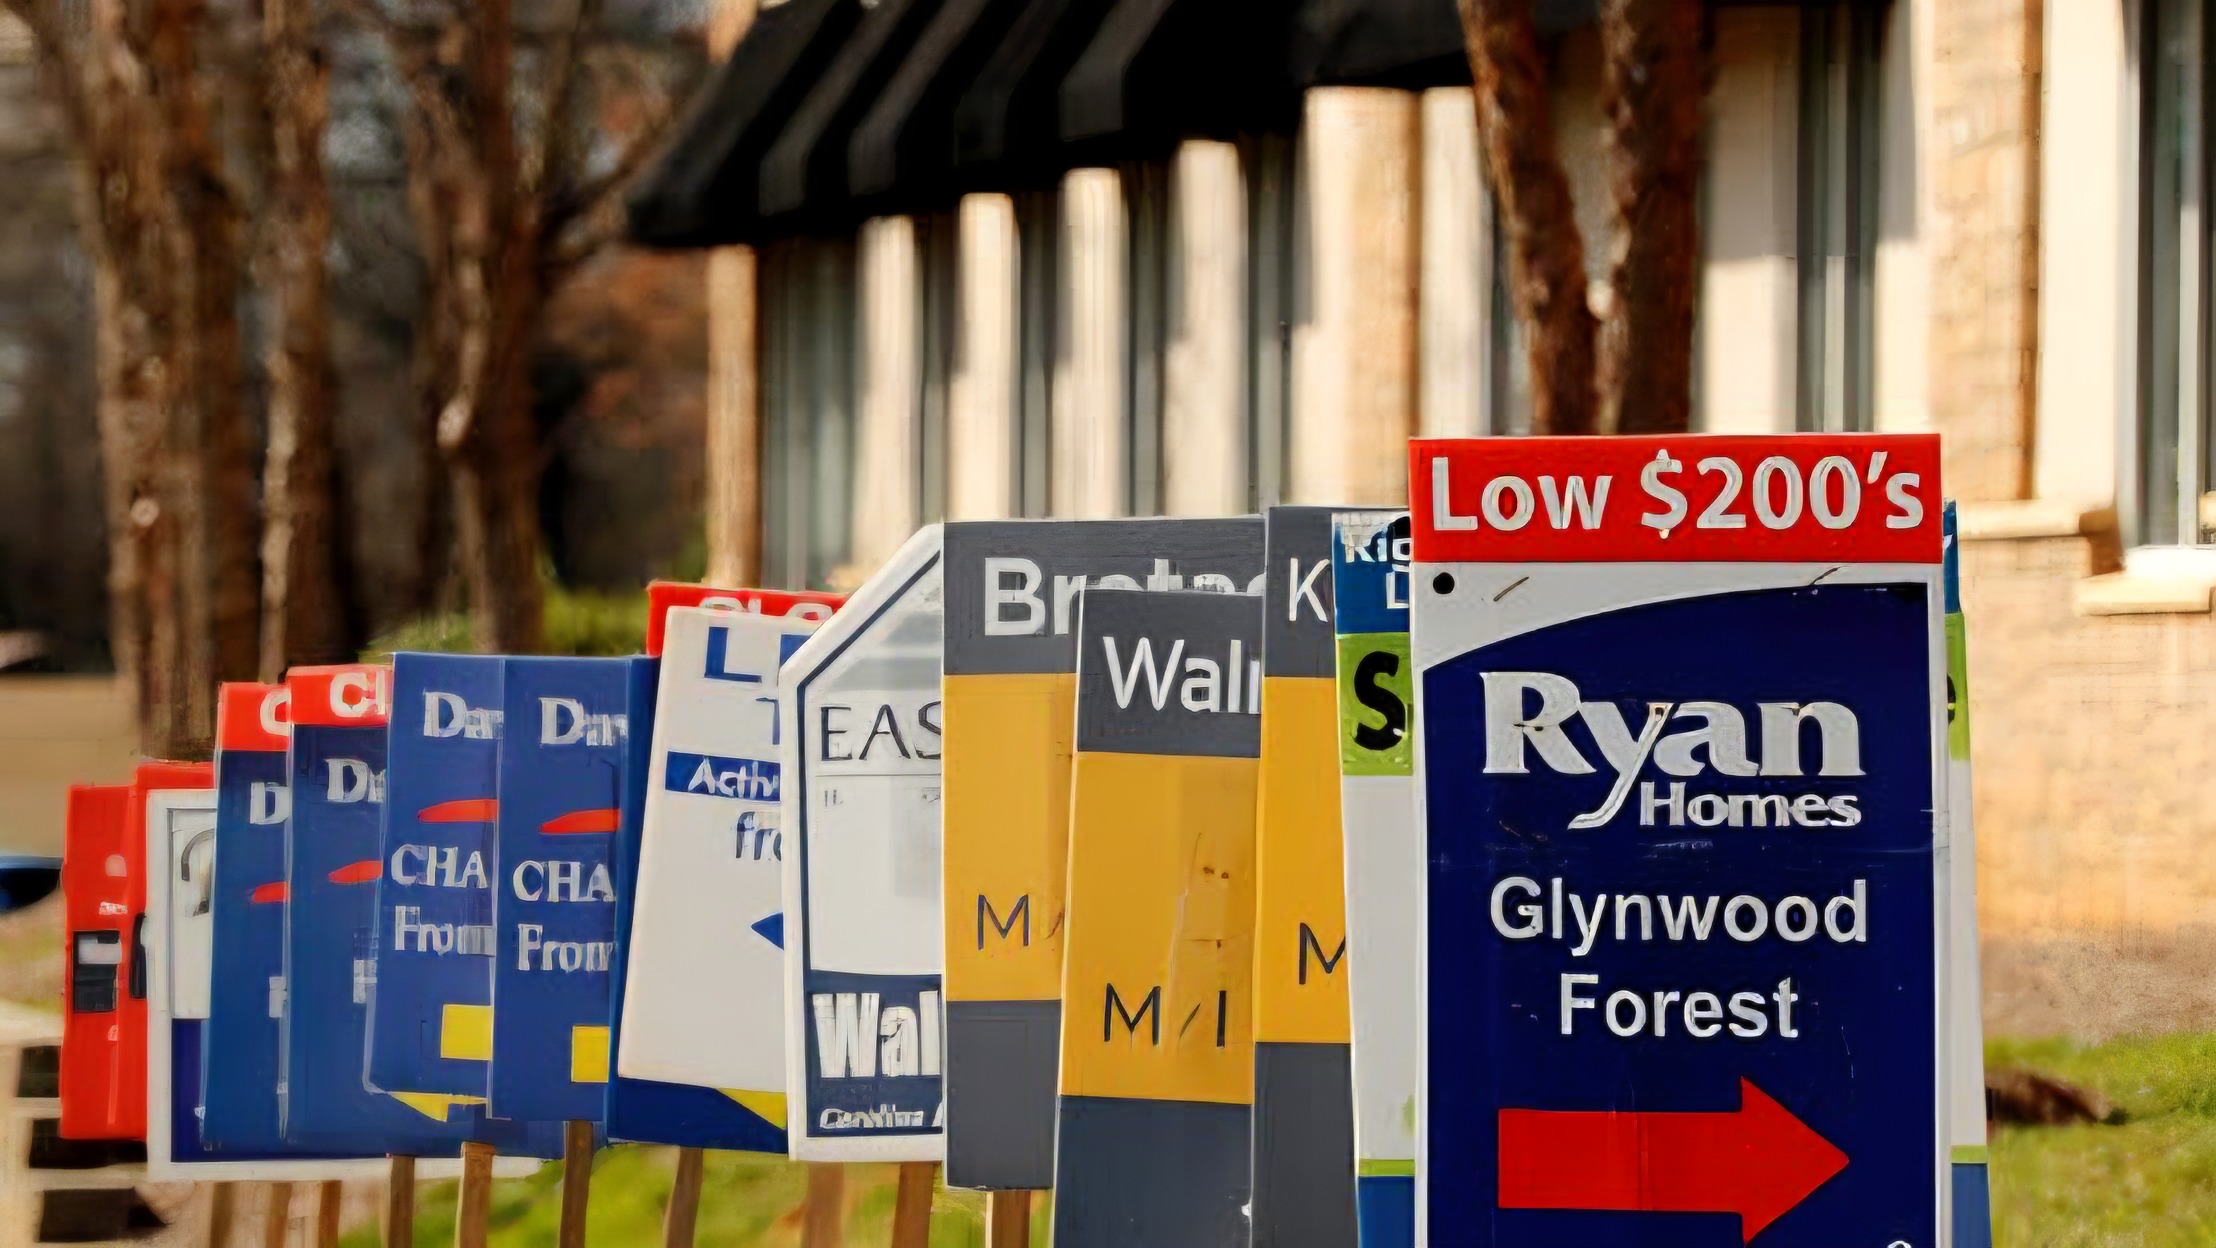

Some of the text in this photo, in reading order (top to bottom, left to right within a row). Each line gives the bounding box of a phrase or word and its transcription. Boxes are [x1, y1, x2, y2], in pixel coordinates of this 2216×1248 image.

[1432, 457, 1612, 531] Low
[1479, 671, 1867, 830] Ryan
[1638, 781, 1863, 828] Homes
[1490, 877, 1868, 957] Glynwood
[1559, 973, 1799, 1039] Forest
